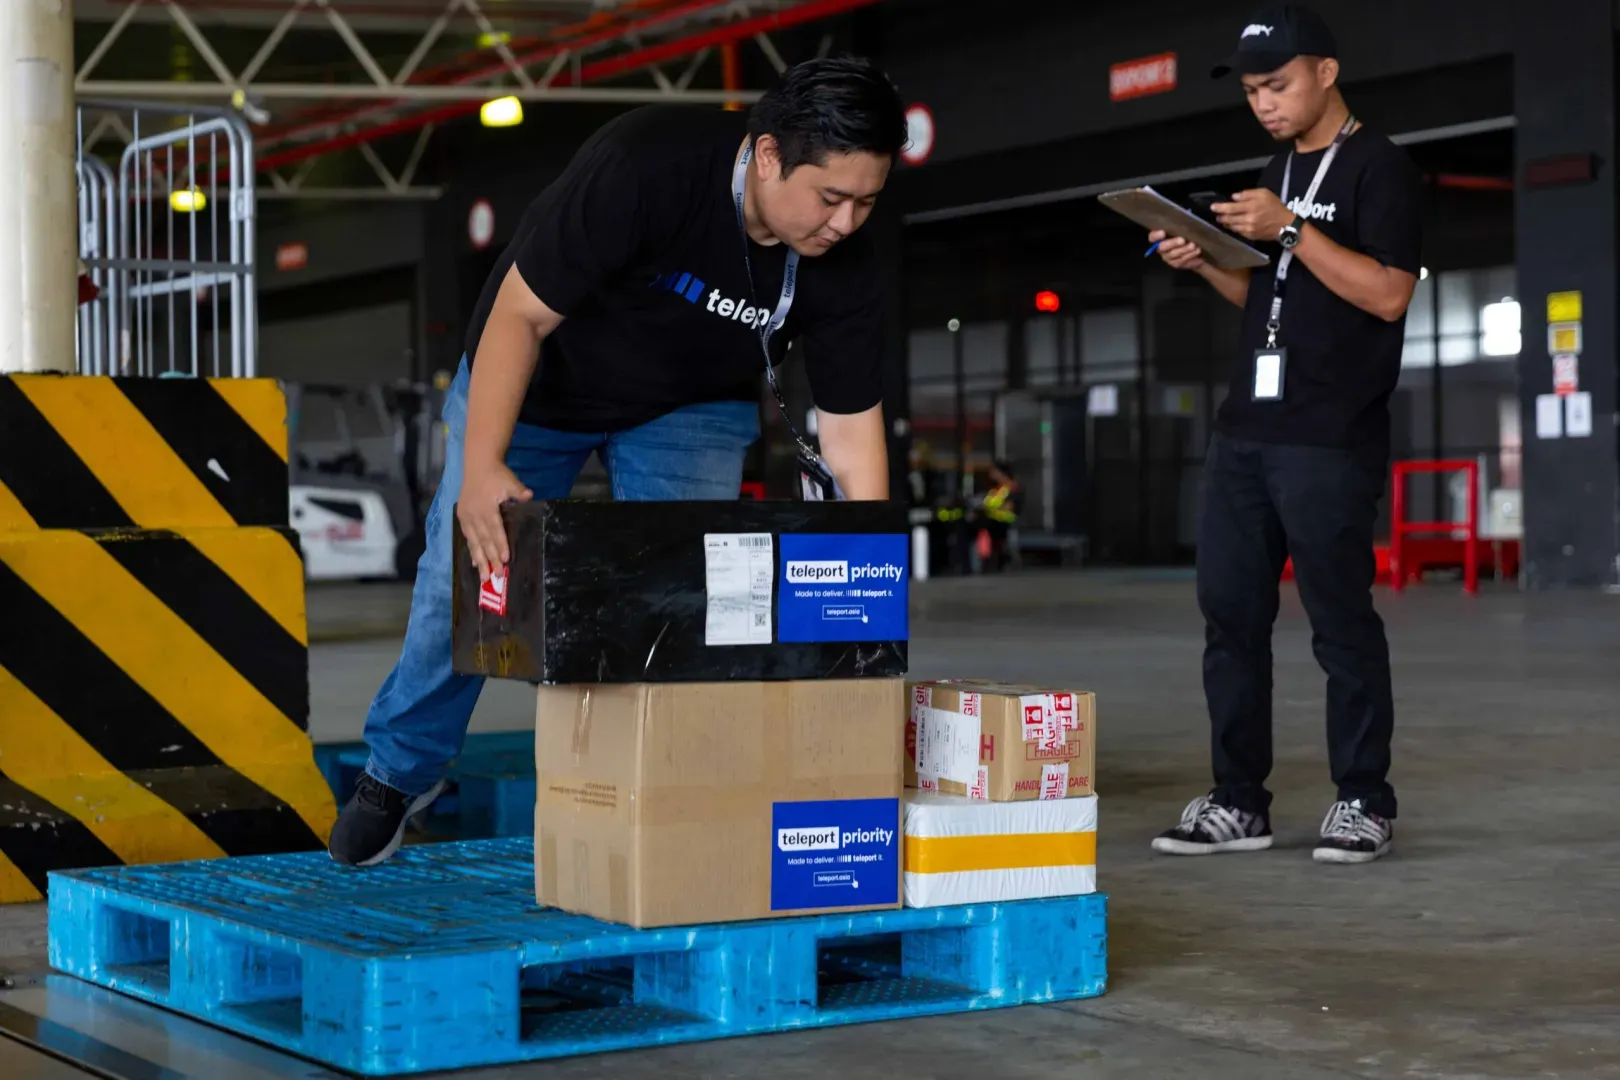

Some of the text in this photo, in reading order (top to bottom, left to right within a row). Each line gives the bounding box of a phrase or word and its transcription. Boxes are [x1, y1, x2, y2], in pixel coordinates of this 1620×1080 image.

[784, 264, 795, 298] teleport
[790, 563, 844, 580] teleport
[851, 562, 903, 582] priority
[822, 589, 845, 597] deliver.
[862, 589, 887, 598] teleport
[826, 608, 860, 616] teleport.asia
[1068, 776, 1089, 788] CARE
[782, 827, 893, 848] teleport priority
[814, 856, 836, 864] deliver.
[853, 854, 877, 863] teleport
[817, 873, 851, 882] teleport.asia
